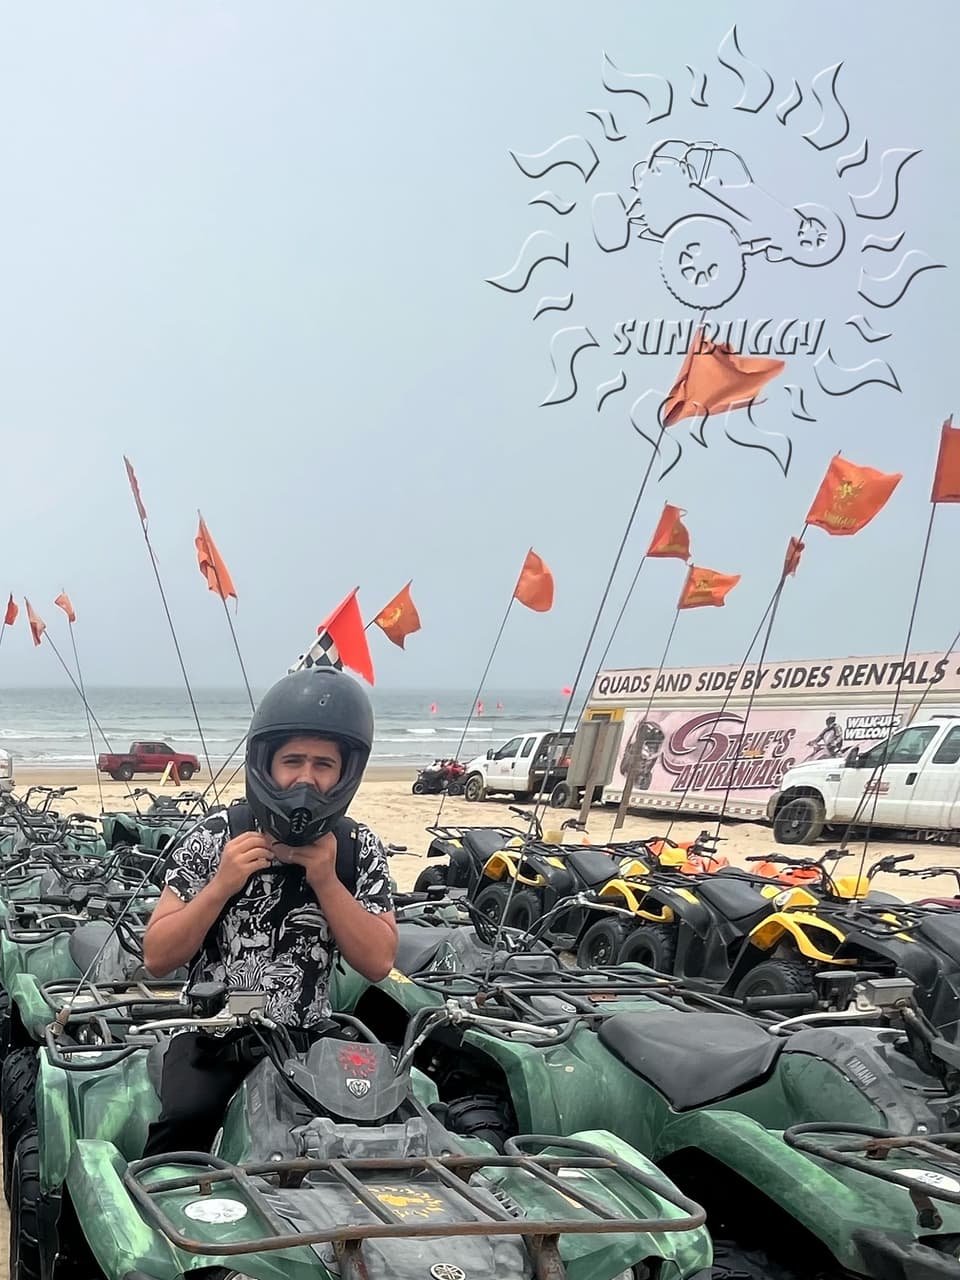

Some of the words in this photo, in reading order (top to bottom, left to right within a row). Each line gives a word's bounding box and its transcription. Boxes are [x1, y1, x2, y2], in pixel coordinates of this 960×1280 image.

[598, 674, 652, 695] QUADS
[654, 673, 692, 693] AND
[695, 671, 738, 691] SIDE
[741, 668, 769, 690] BY
[770, 665, 833, 689] SIDES
[837, 659, 949, 687] RENTALS
[671, 763, 718, 791] ATV
[706, 757, 796, 789] RENTALS
[846, 1057, 878, 1087] YAMAHA
